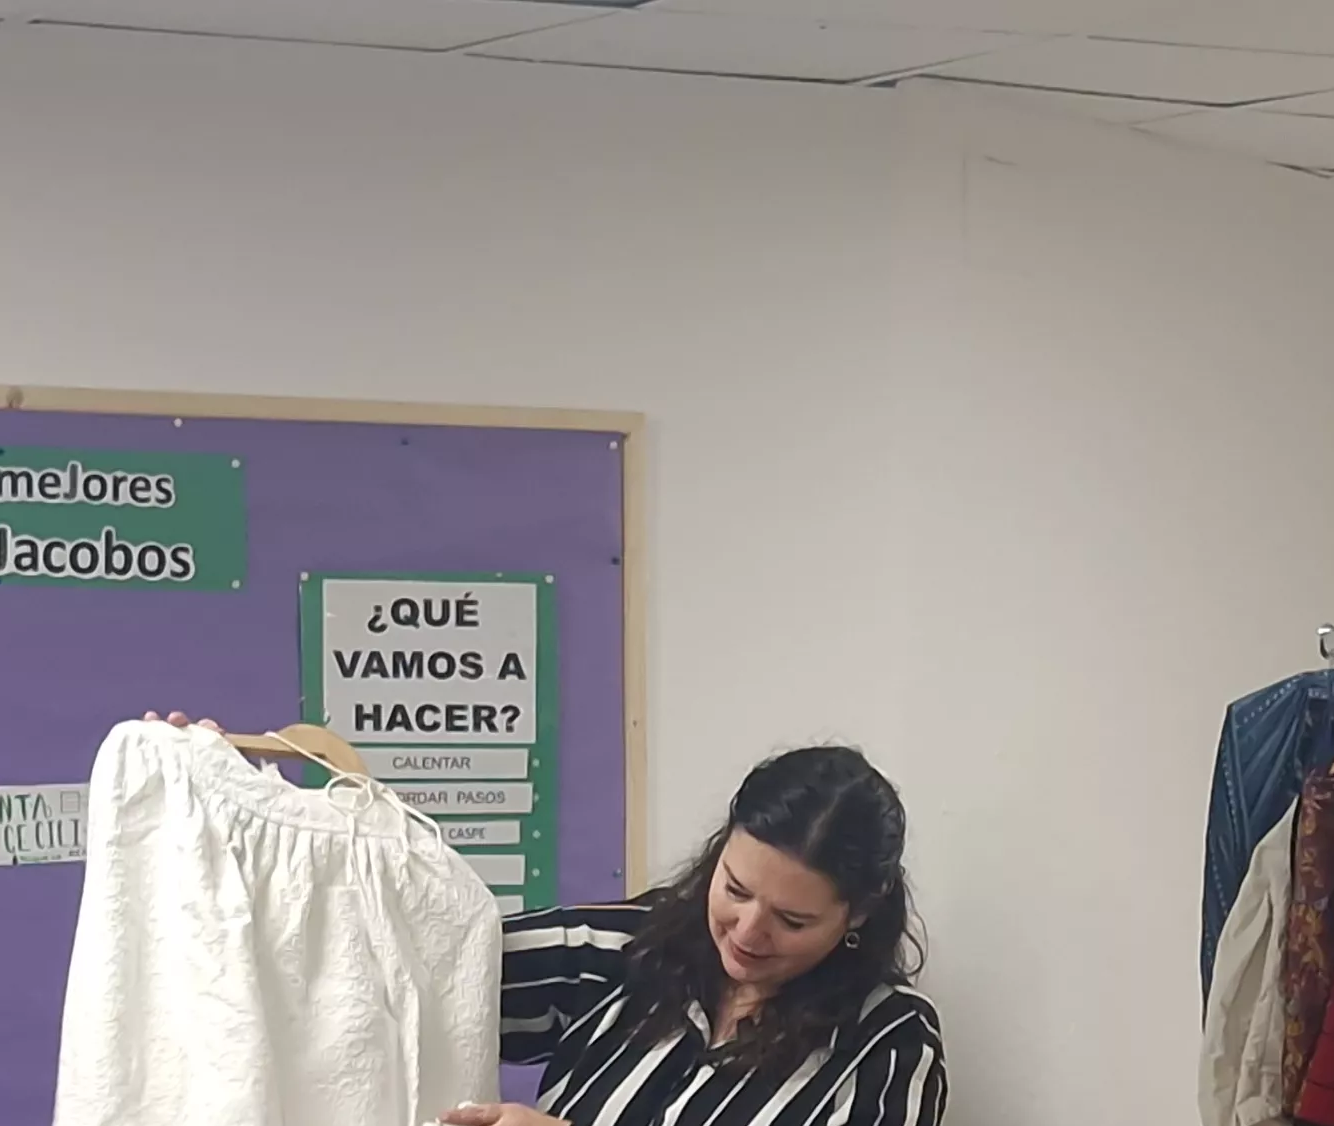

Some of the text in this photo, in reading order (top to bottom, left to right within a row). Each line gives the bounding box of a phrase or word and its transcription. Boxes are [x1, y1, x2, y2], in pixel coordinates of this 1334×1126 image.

[367, 591, 480, 634] ¿QUÉ
[333, 650, 527, 680] VAMOS A
[355, 704, 521, 733] HACER?
[392, 756, 471, 770] CALENTAR
[396, 791, 506, 804] ORDAR PASOS
[4, 818, 87, 854] CECILI
[448, 828, 486, 840] CASPE
